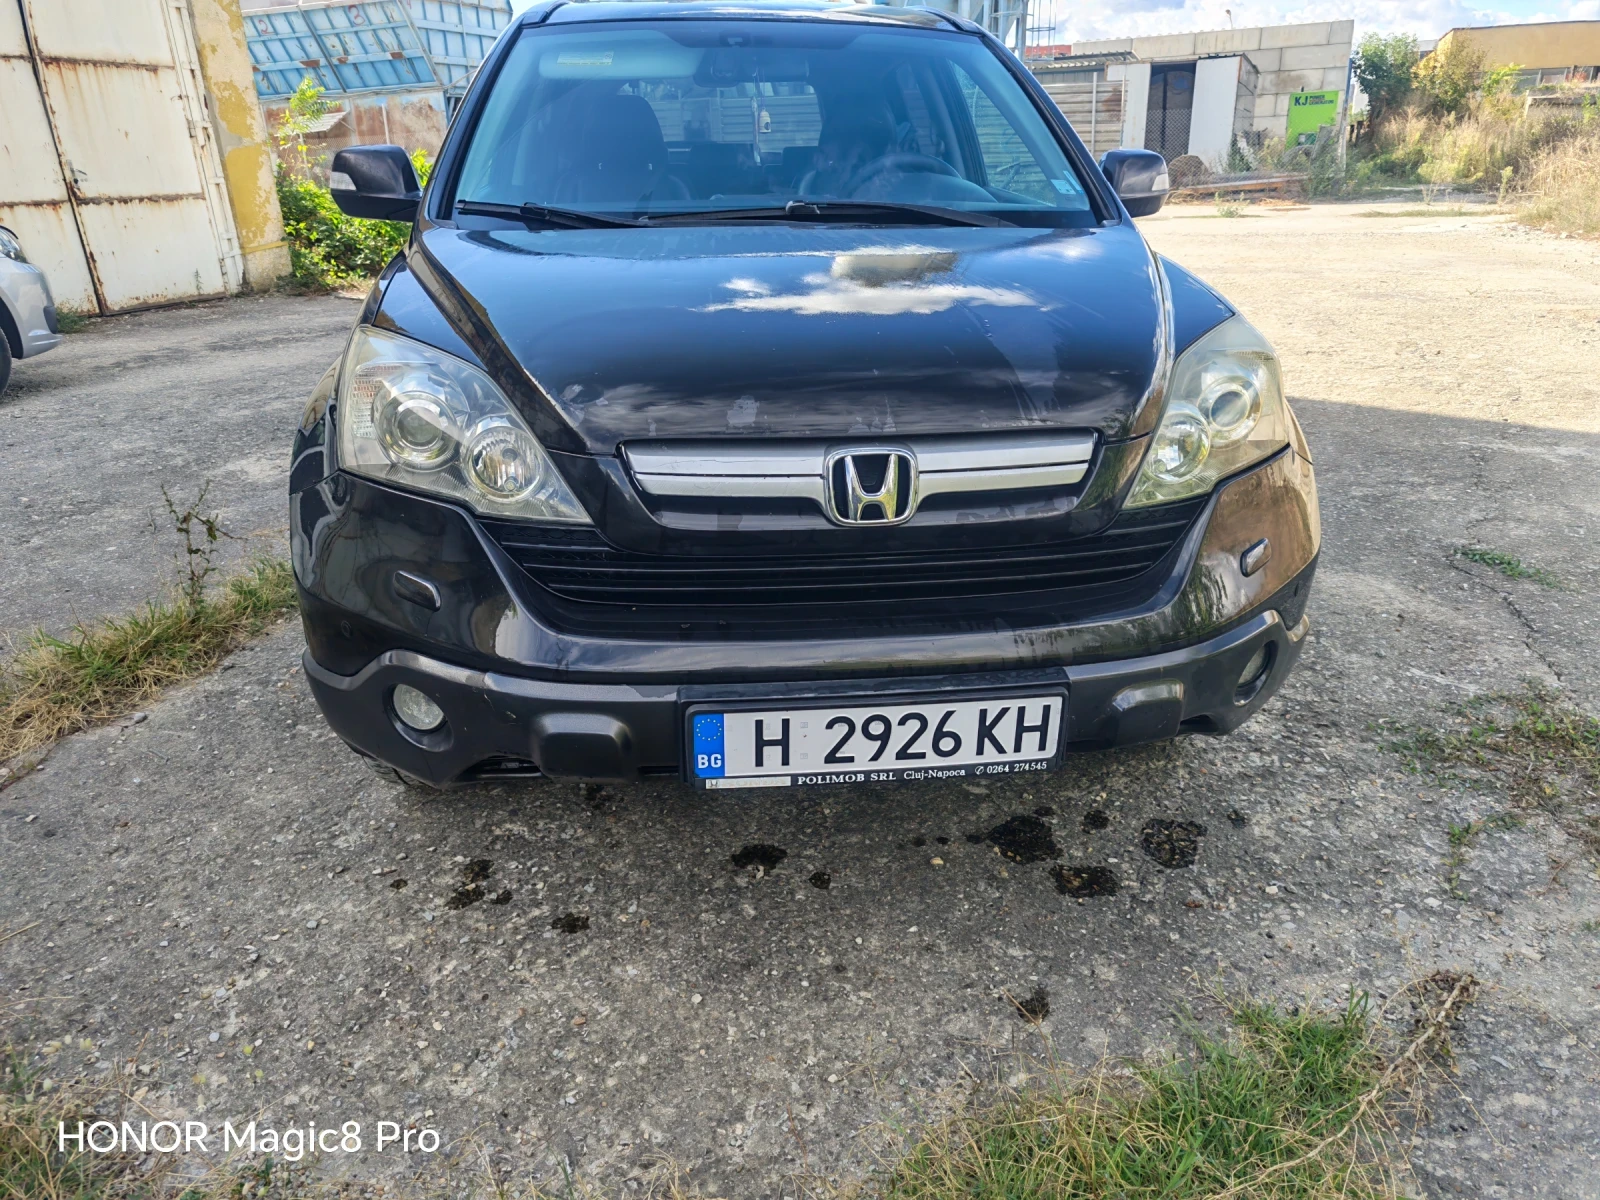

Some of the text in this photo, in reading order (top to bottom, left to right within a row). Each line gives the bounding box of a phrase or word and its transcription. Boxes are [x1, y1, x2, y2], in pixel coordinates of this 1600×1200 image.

[348, 5, 366, 26] 3
[258, 19, 276, 34] 2
[1294, 95, 1308, 106] KJ
[754, 704, 1052, 768] H 2926 KH
[697, 753, 722, 769] BG
[797, 773, 865, 785] POLIMOB
[870, 772, 897, 782] SRL
[903, 768, 966, 781] Cluj-Napoca
[986, 764, 1010, 774] 0264
[1013, 761, 1048, 772] 274545
